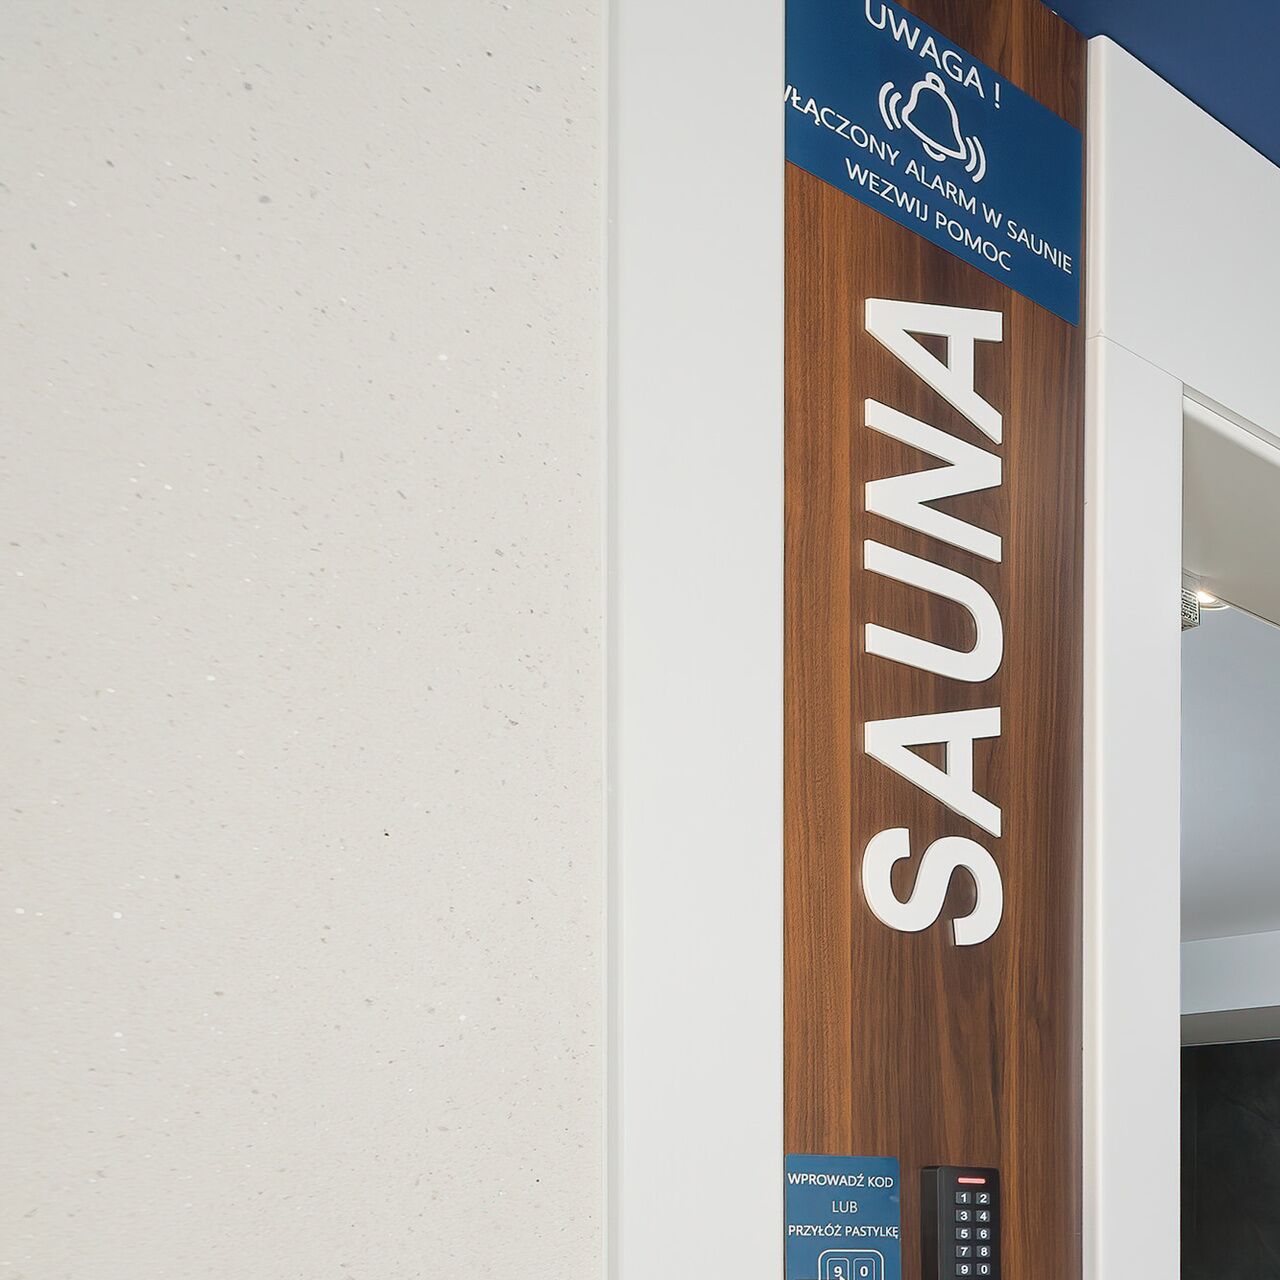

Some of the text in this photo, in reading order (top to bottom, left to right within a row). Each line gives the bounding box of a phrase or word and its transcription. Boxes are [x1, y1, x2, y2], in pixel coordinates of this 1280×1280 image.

[865, 0, 1000, 109] UWAGA !
[844, 157, 1012, 272] WEZWIJ POMOC
[904, 159, 976, 215] ALARM
[981, 202, 1003, 229] W
[1007, 220, 1073, 275] SAUNIE
[861, 297, 1004, 947] SAUNA
[787, 1172, 894, 1188] WPROWADŹ KOD
[961, 1193, 987, 1203] 1 2
[832, 1200, 858, 1213] LUB
[960, 1211, 987, 1221] 3 4
[788, 1223, 899, 1239] PRZYŁÓŻ PASTYLKĘ
[960, 1229, 987, 1239] 5 6
[960, 1247, 988, 1257] 7 8
[833, 1266, 869, 1277] 9 0
[961, 1265, 988, 1275] 9 0
